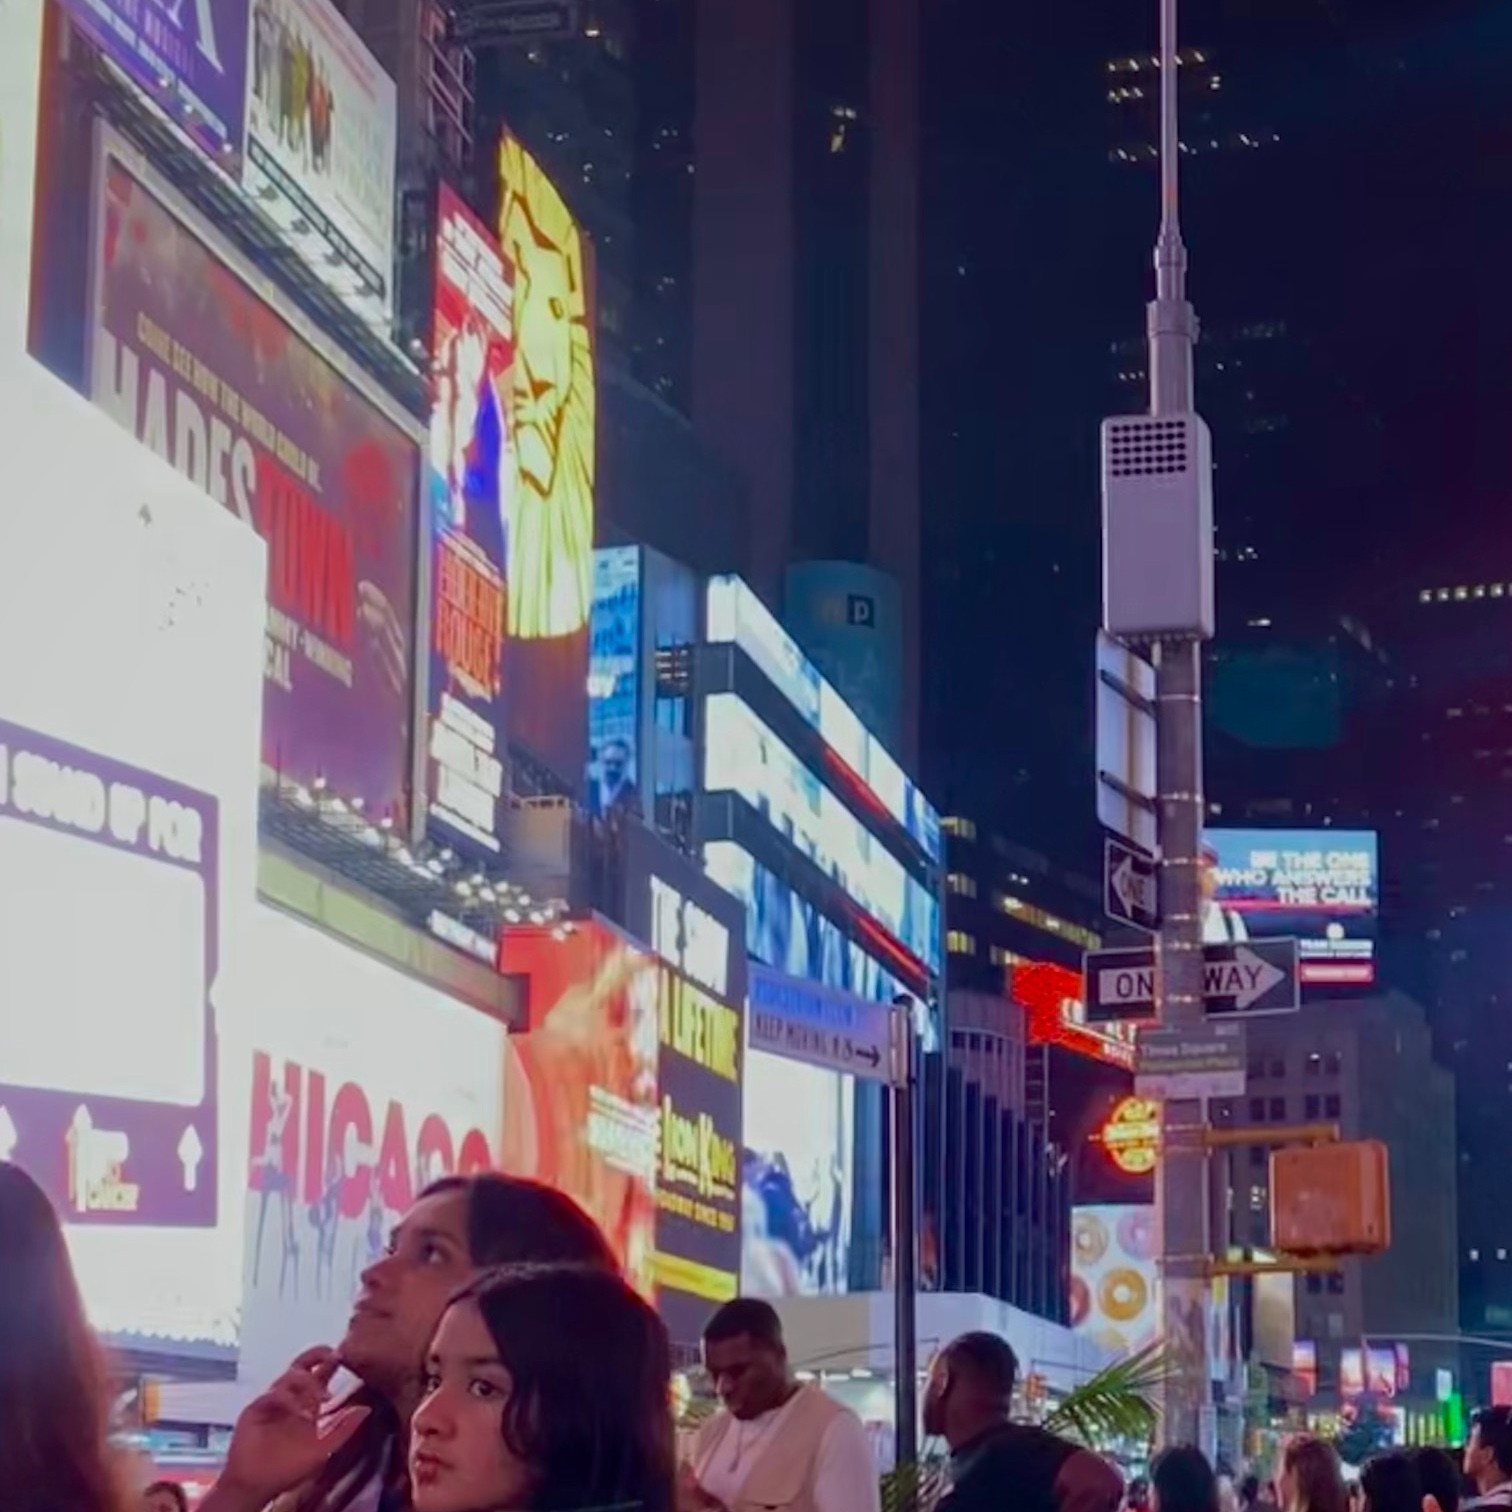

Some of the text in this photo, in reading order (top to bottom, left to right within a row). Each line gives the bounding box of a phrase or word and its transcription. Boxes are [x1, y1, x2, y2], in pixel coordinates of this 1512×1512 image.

[1281, 851, 1322, 868] THE
[1209, 867, 1268, 886] WHO
[1277, 886, 1372, 906] THE CALL
[1116, 962, 1264, 999] ON WAY
